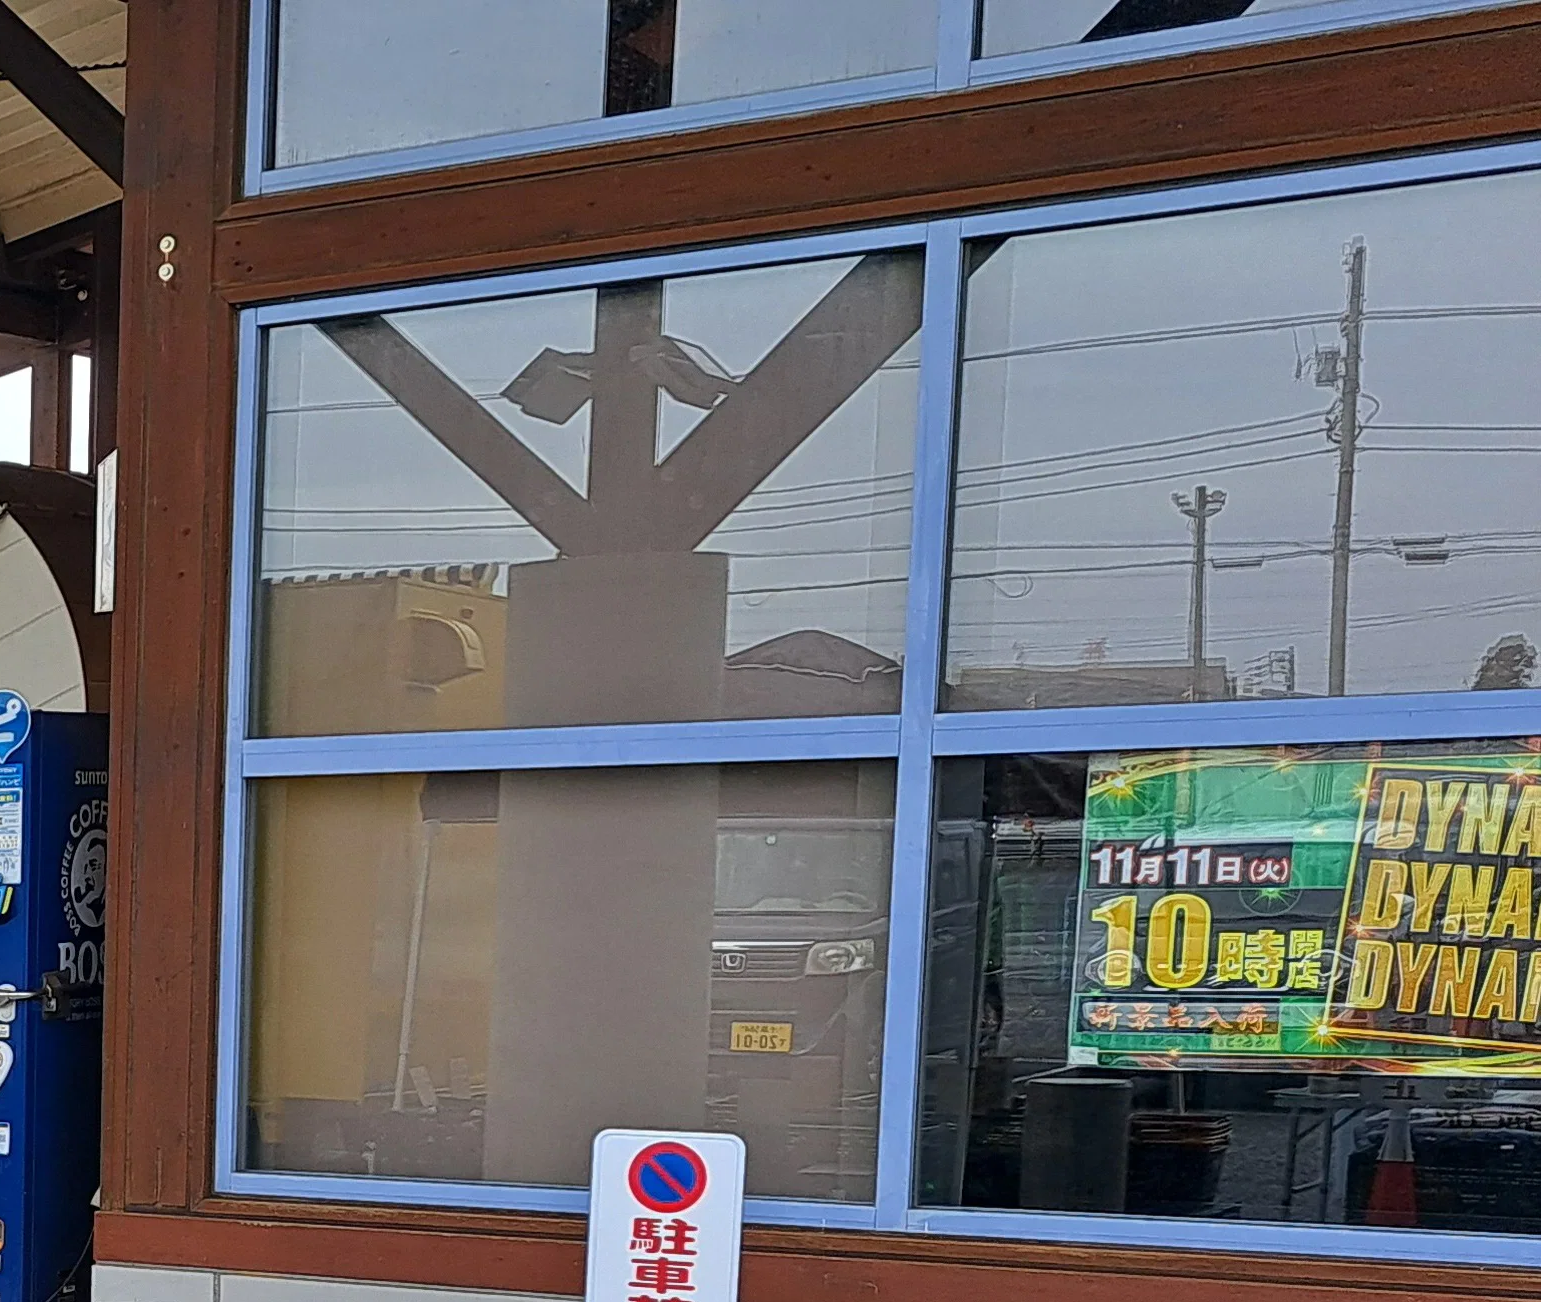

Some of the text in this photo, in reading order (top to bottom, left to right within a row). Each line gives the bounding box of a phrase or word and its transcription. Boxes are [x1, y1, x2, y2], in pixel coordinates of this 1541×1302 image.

[1090, 844, 1291, 887] 11月11日(火)
[1360, 858, 1541, 941] DYNA
